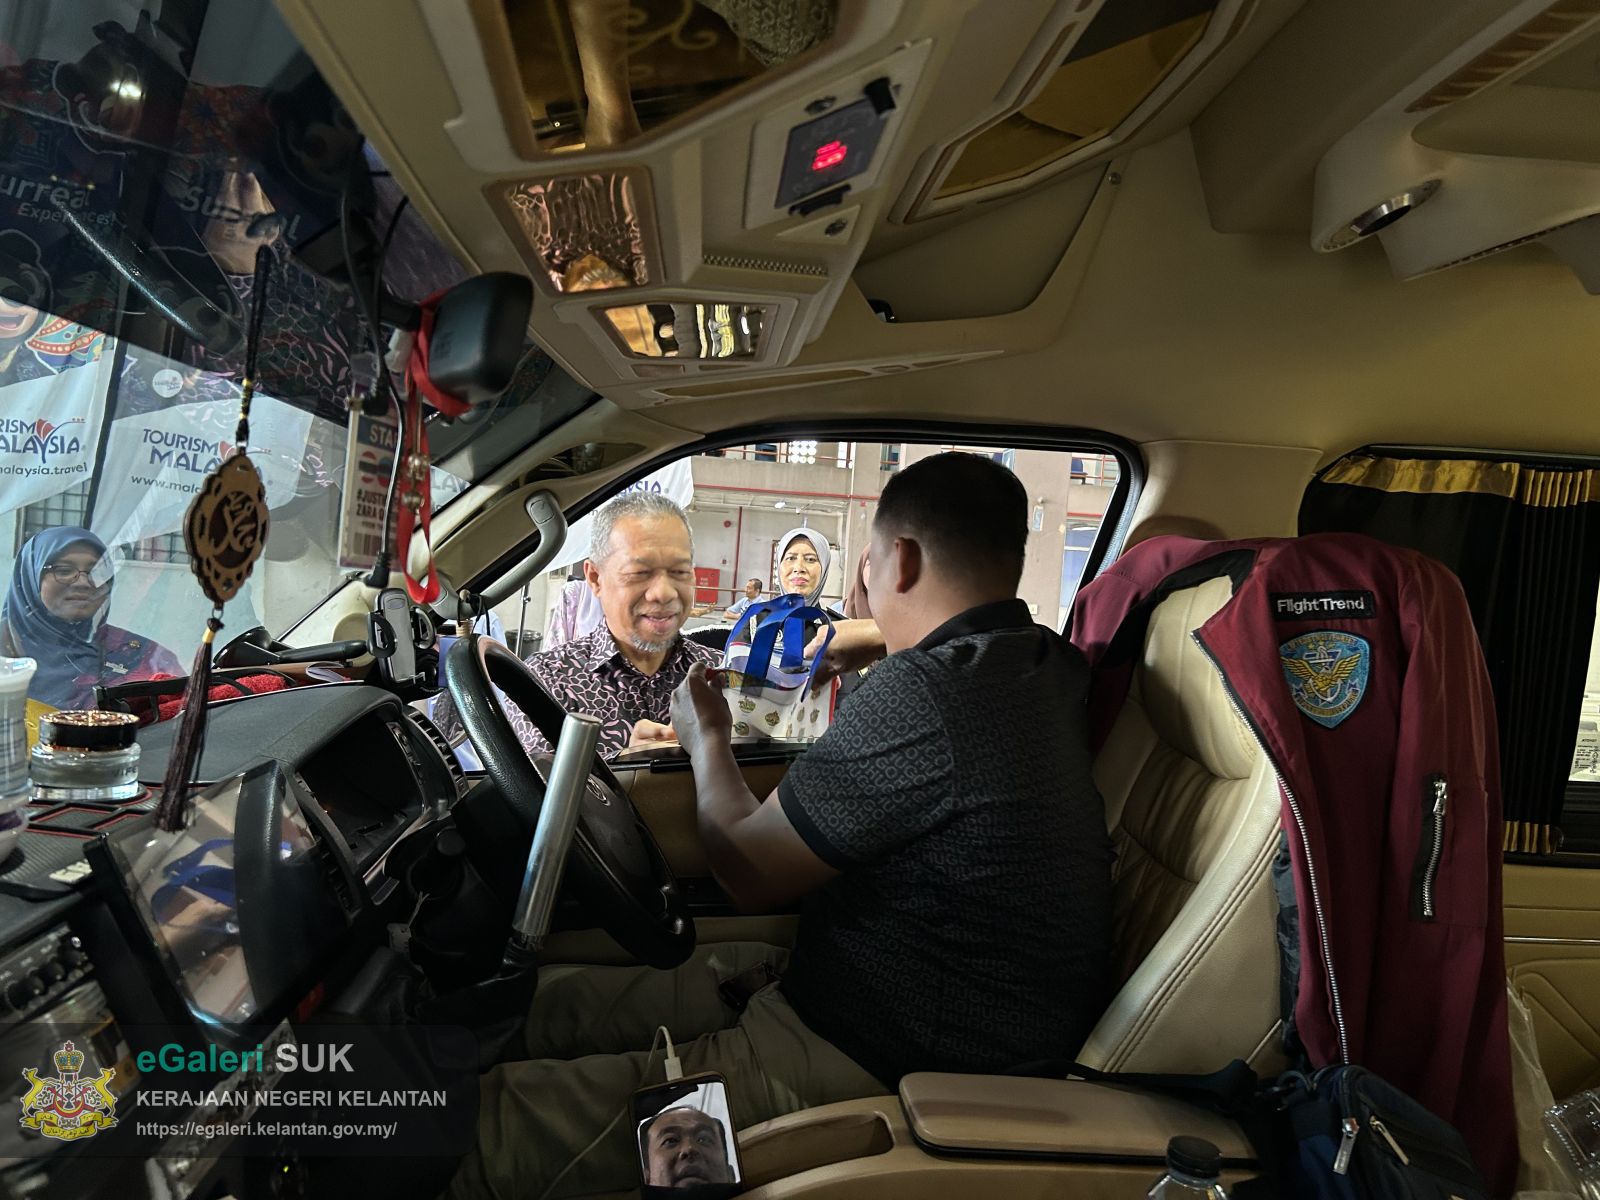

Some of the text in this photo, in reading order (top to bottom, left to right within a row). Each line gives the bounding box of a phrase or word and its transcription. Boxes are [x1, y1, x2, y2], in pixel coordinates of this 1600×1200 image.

[143, 429, 219, 456] TOURISM
[1277, 596, 1365, 615] Flight Trend
